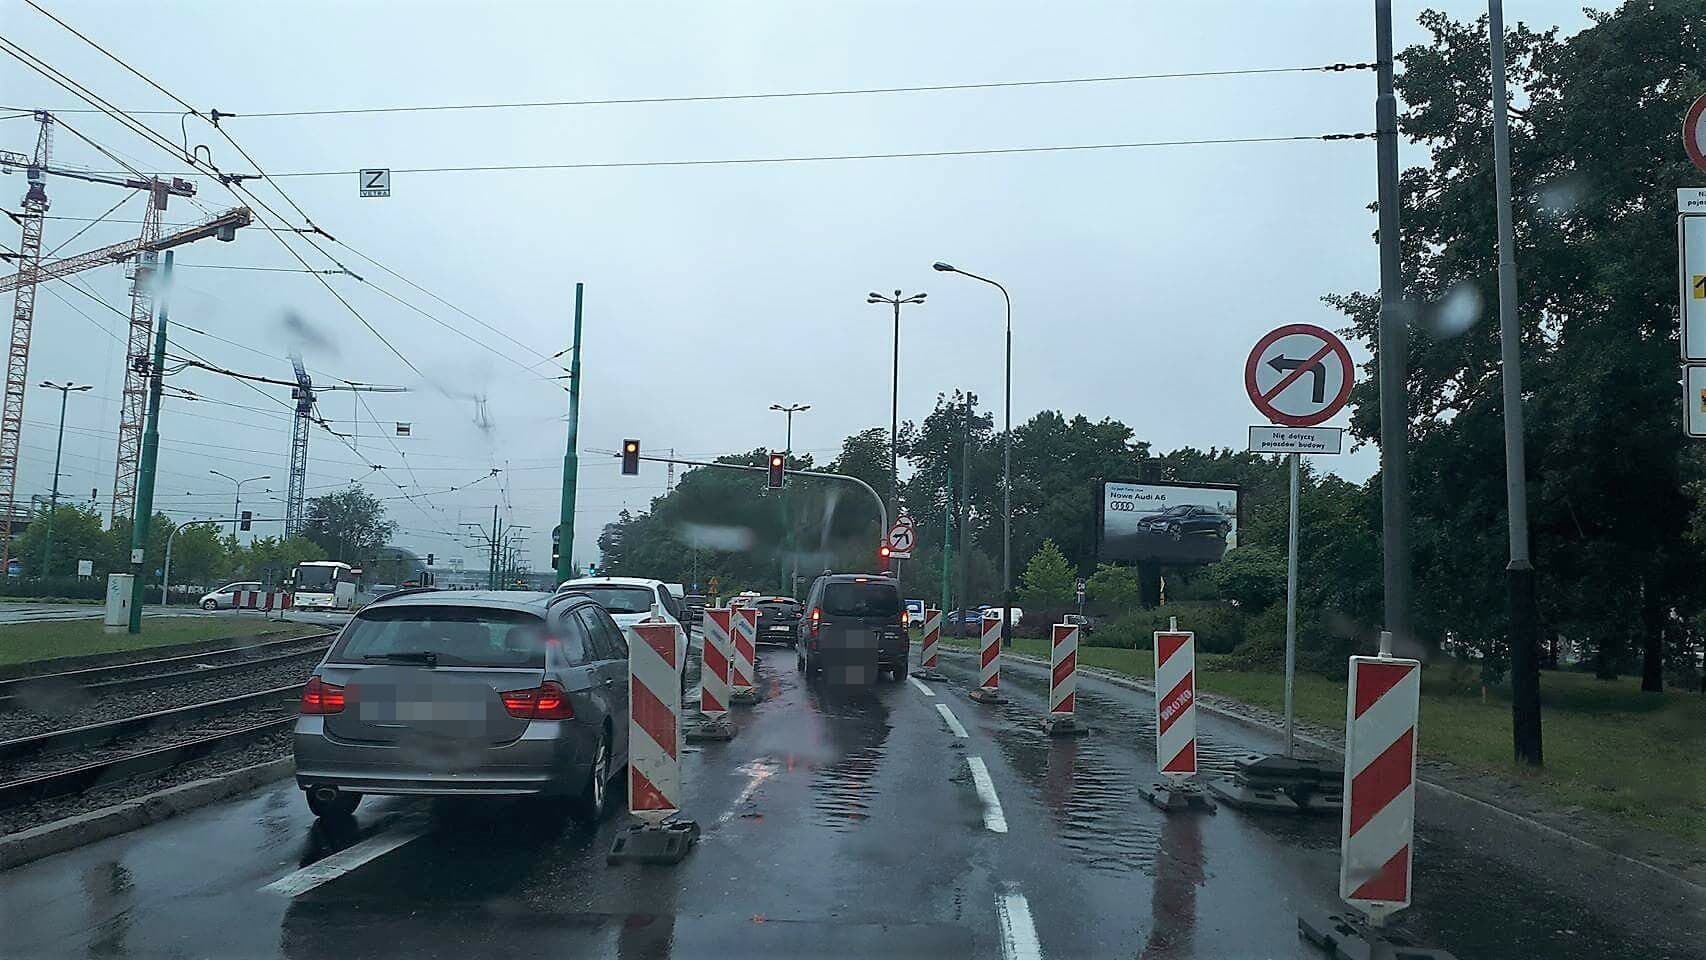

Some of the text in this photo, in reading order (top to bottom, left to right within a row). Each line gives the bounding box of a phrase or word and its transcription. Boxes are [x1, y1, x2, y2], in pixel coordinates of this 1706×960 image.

[366, 171, 384, 188] Z
[1288, 432, 1315, 441] dotyczy
[1261, 441, 1295, 449] pojazdów
[1298, 441, 1325, 450] budowy
[1110, 492, 1133, 500] Nowe
